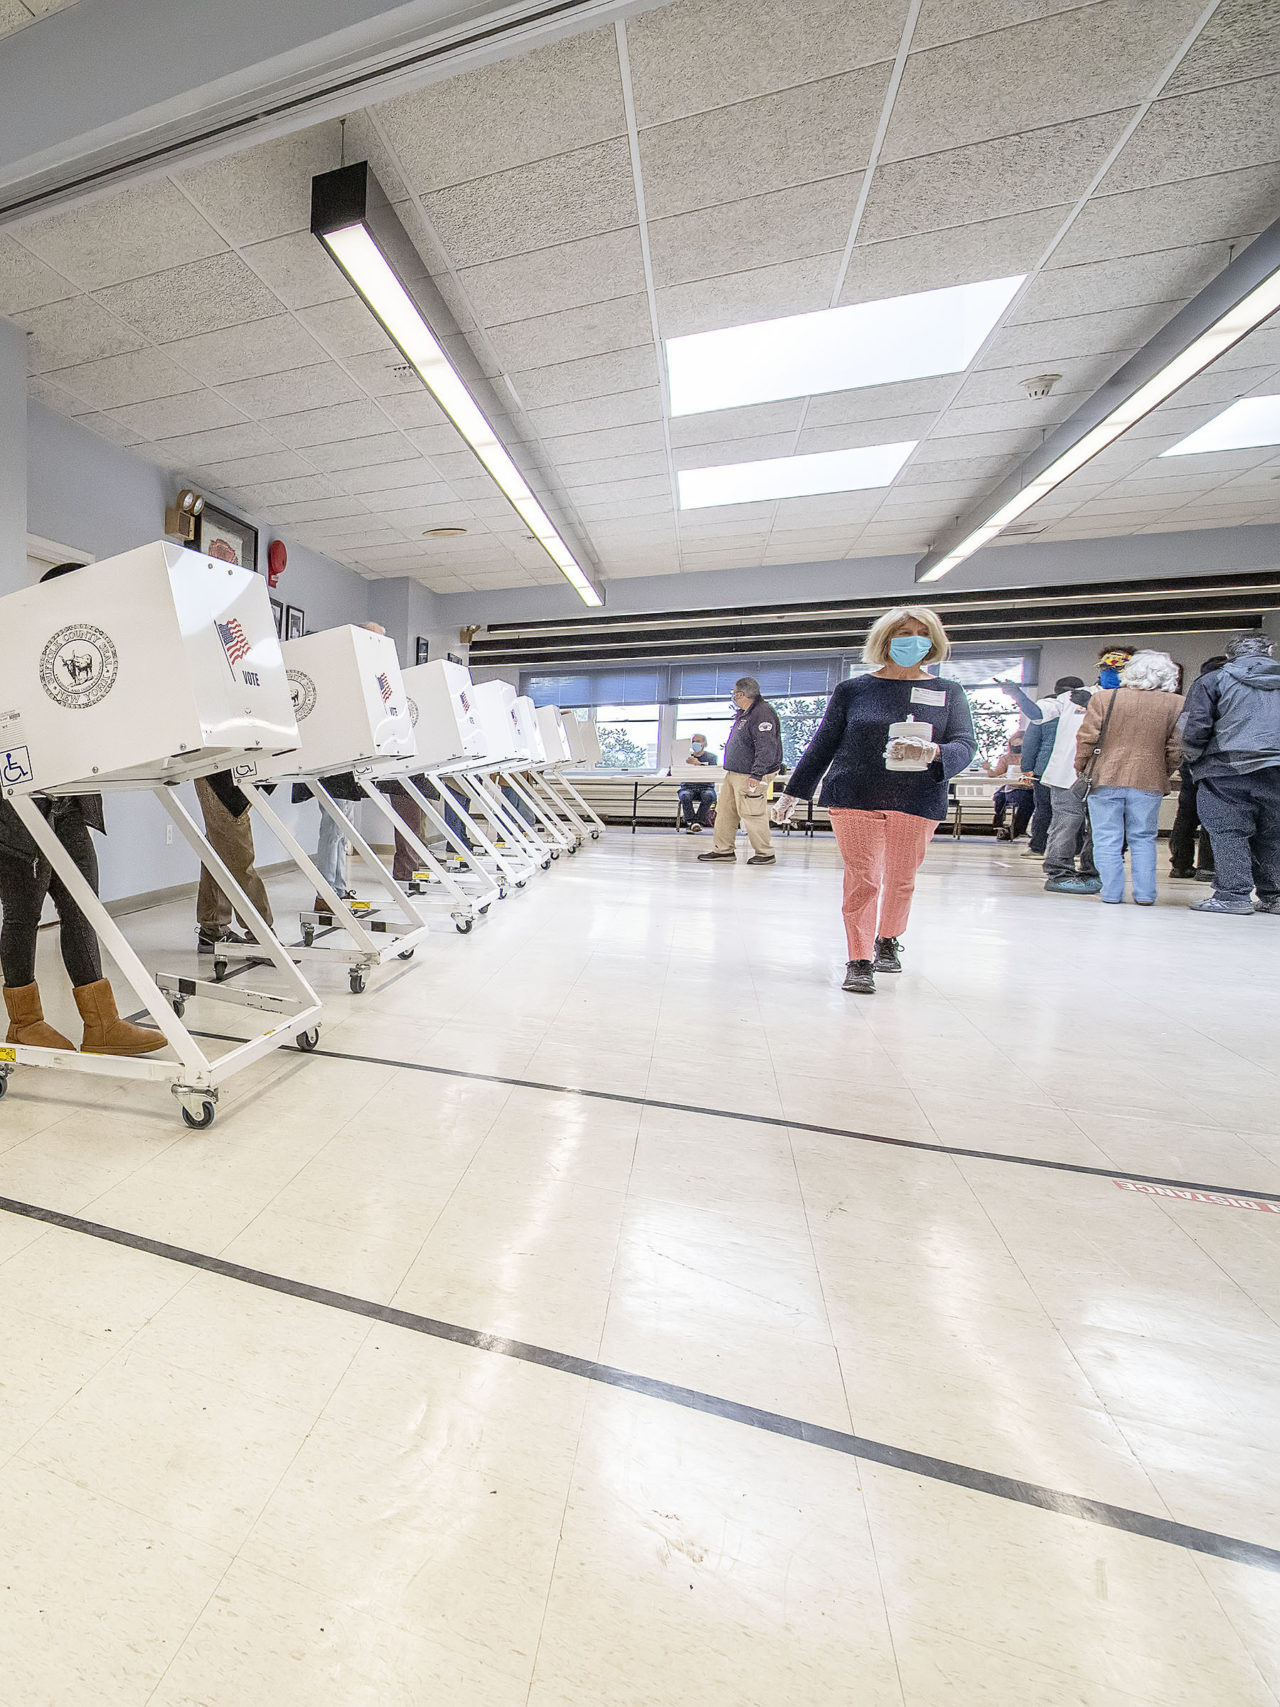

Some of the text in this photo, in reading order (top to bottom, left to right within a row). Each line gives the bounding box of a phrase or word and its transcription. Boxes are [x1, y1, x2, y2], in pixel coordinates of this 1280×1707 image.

[44, 640, 63, 685] SUFFOLK
[63, 630, 101, 643] COUNTY
[99, 642, 113, 669] SEAL
[55, 689, 80, 703] NEW
[84, 674, 110, 702] YORK
[242, 670, 260, 687] VOTE
[1118, 1181, 1262, 1211] DISTANCE
